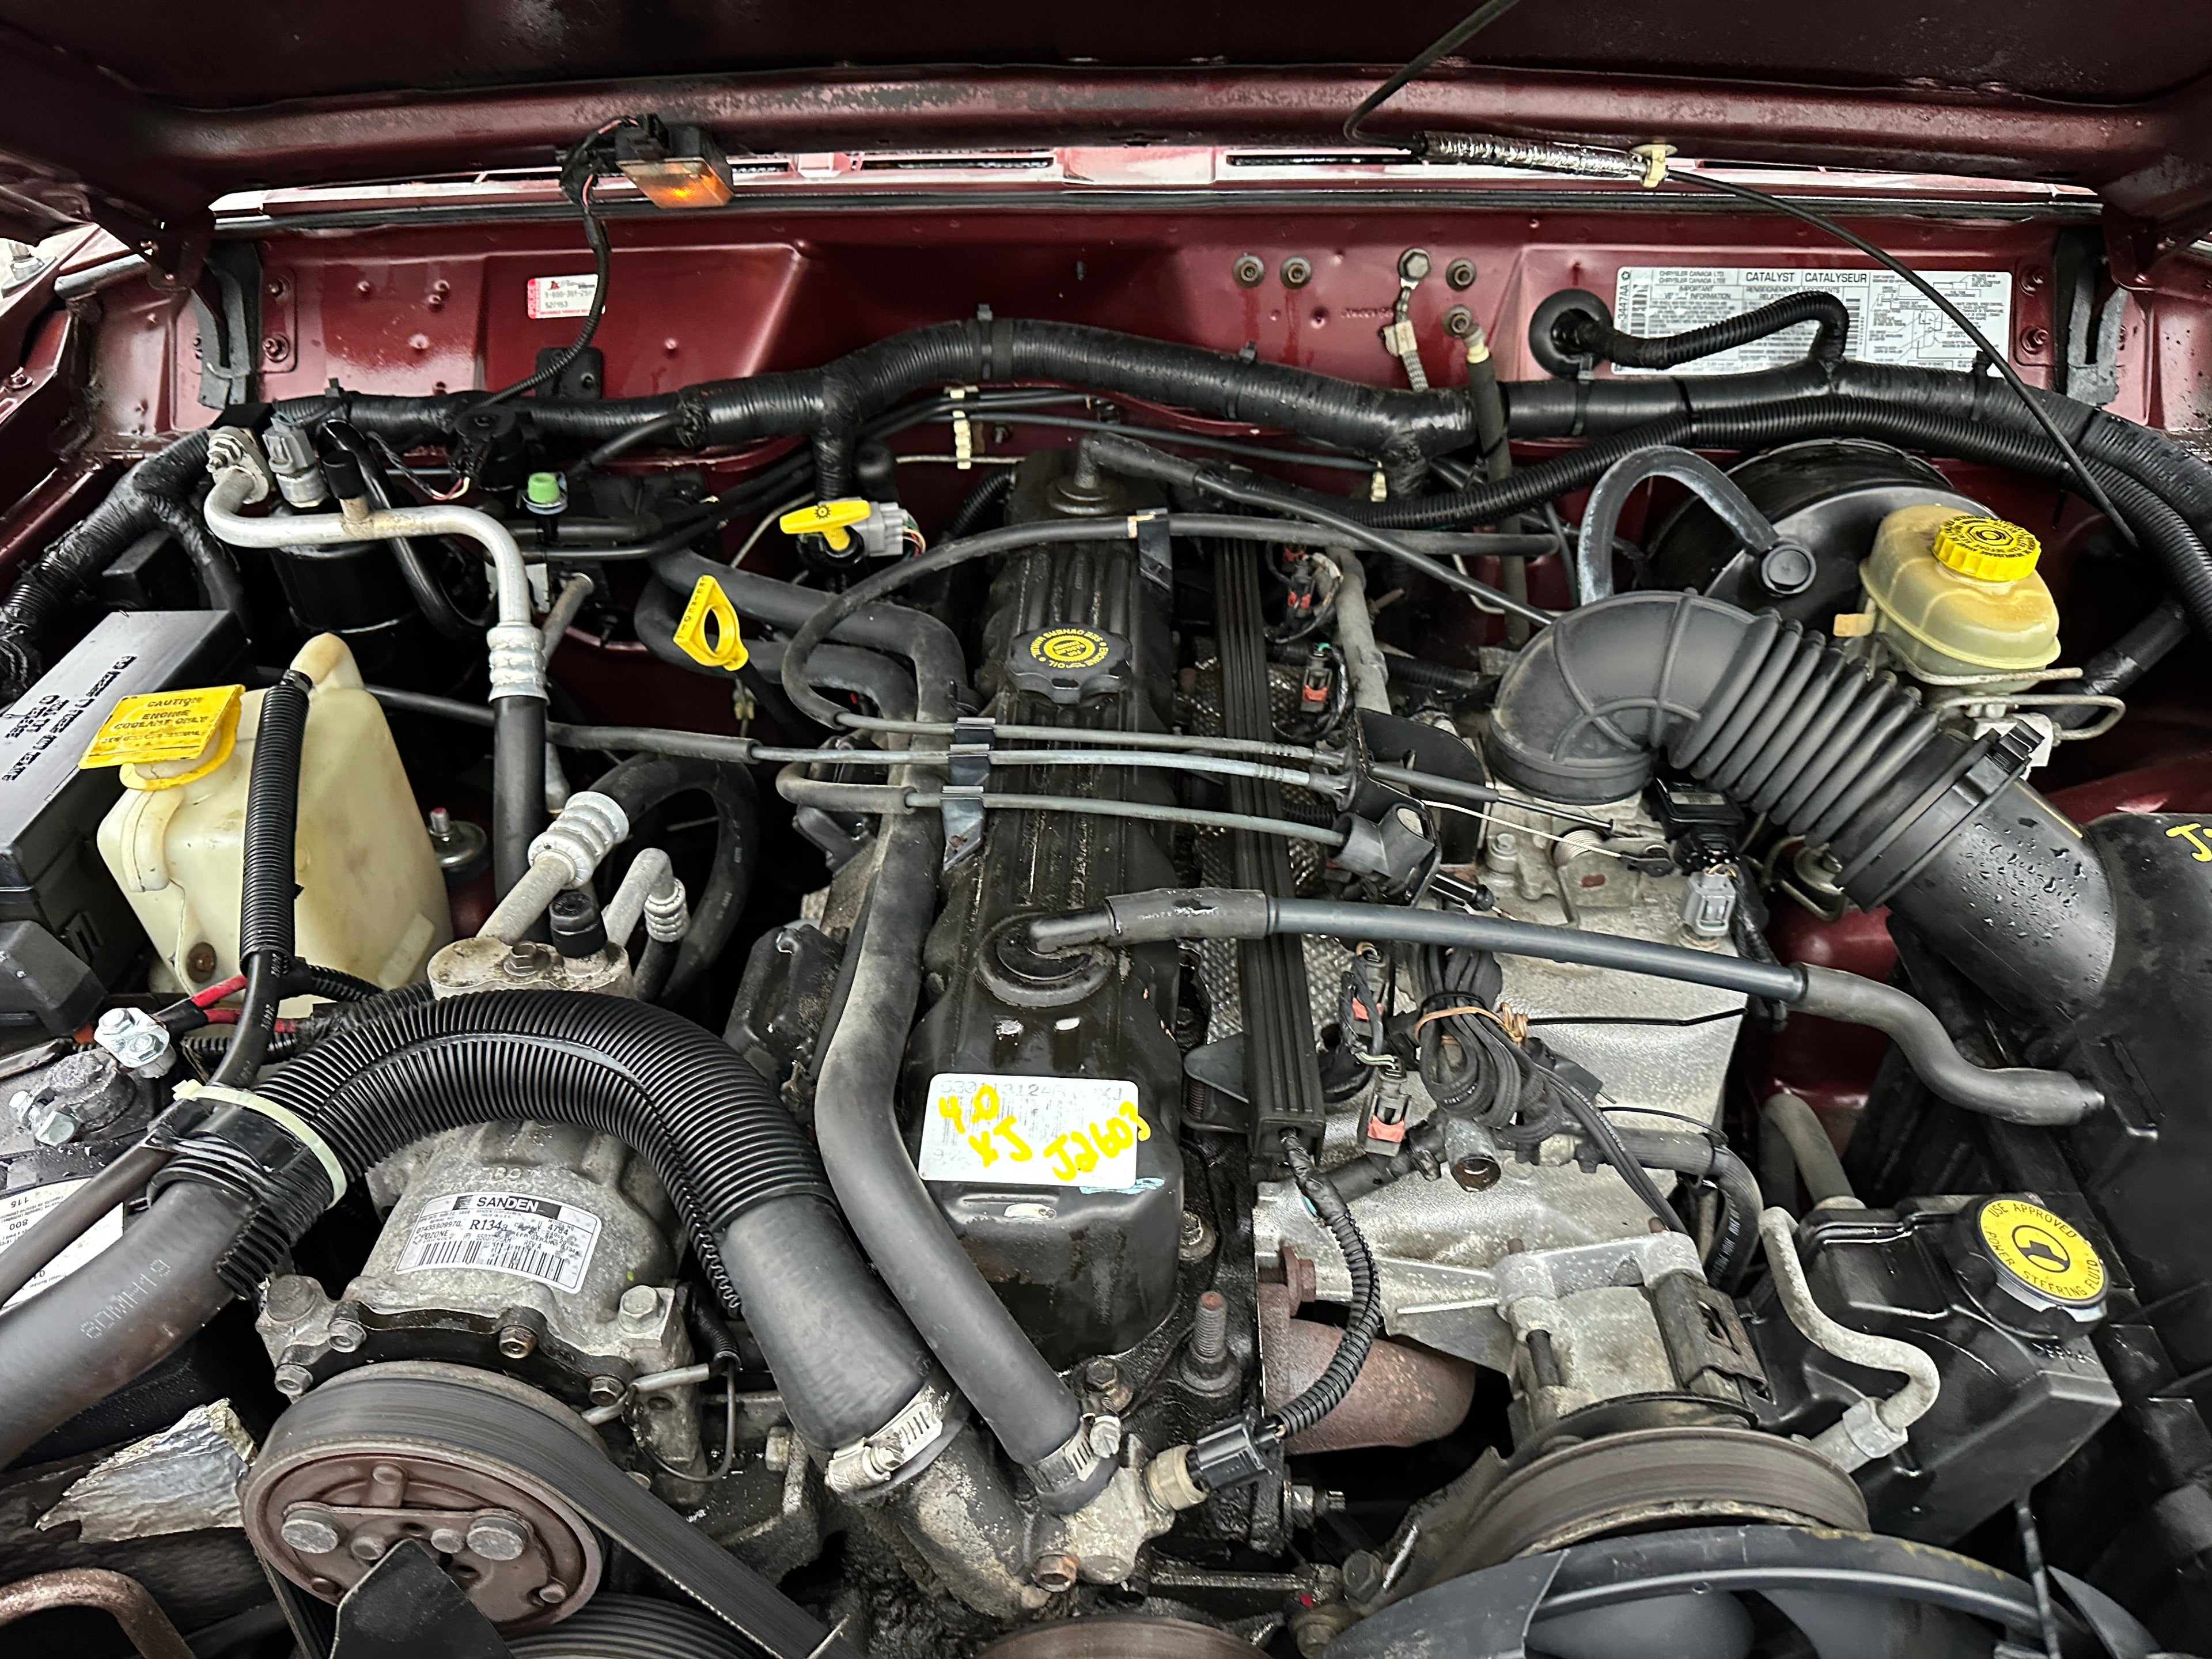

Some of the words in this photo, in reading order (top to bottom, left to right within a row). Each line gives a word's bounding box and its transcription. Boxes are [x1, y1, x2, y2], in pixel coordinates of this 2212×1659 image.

[1746, 272, 1795, 282] CATALYST
[1805, 272, 1867, 283] CATALYSEUR
[688, 577, 707, 613] ENGINE
[676, 615, 692, 639] OIL
[1043, 628, 1085, 639] OWNERS
[1084, 631, 1104, 643] SEE
[1084, 646, 1109, 666] ENGINE
[1048, 660, 1066, 669] OIL
[147, 697, 203, 707] CAUTION
[141, 710, 192, 720] ENGINE
[175, 716, 209, 725] ONLY
[939, 1084, 999, 1134] 4.0
[968, 1115, 1033, 1168] XJ
[10, 1196, 29, 1209] 115
[476, 1197, 539, 1212] SANDEN
[9, 1218, 29, 1230] 800
[469, 1219, 508, 1232] R134a
[1987, 1203, 2009, 1218] USE
[2014, 1203, 2077, 1238] APPROVED
[424, 1229, 450, 1240] OZONE
[547, 1224, 569, 1236] 4784
[1985, 1230, 2016, 1266] POWER
[2022, 1270, 2089, 1297] STEERING
[2084, 1259, 2099, 1290] FLUID
